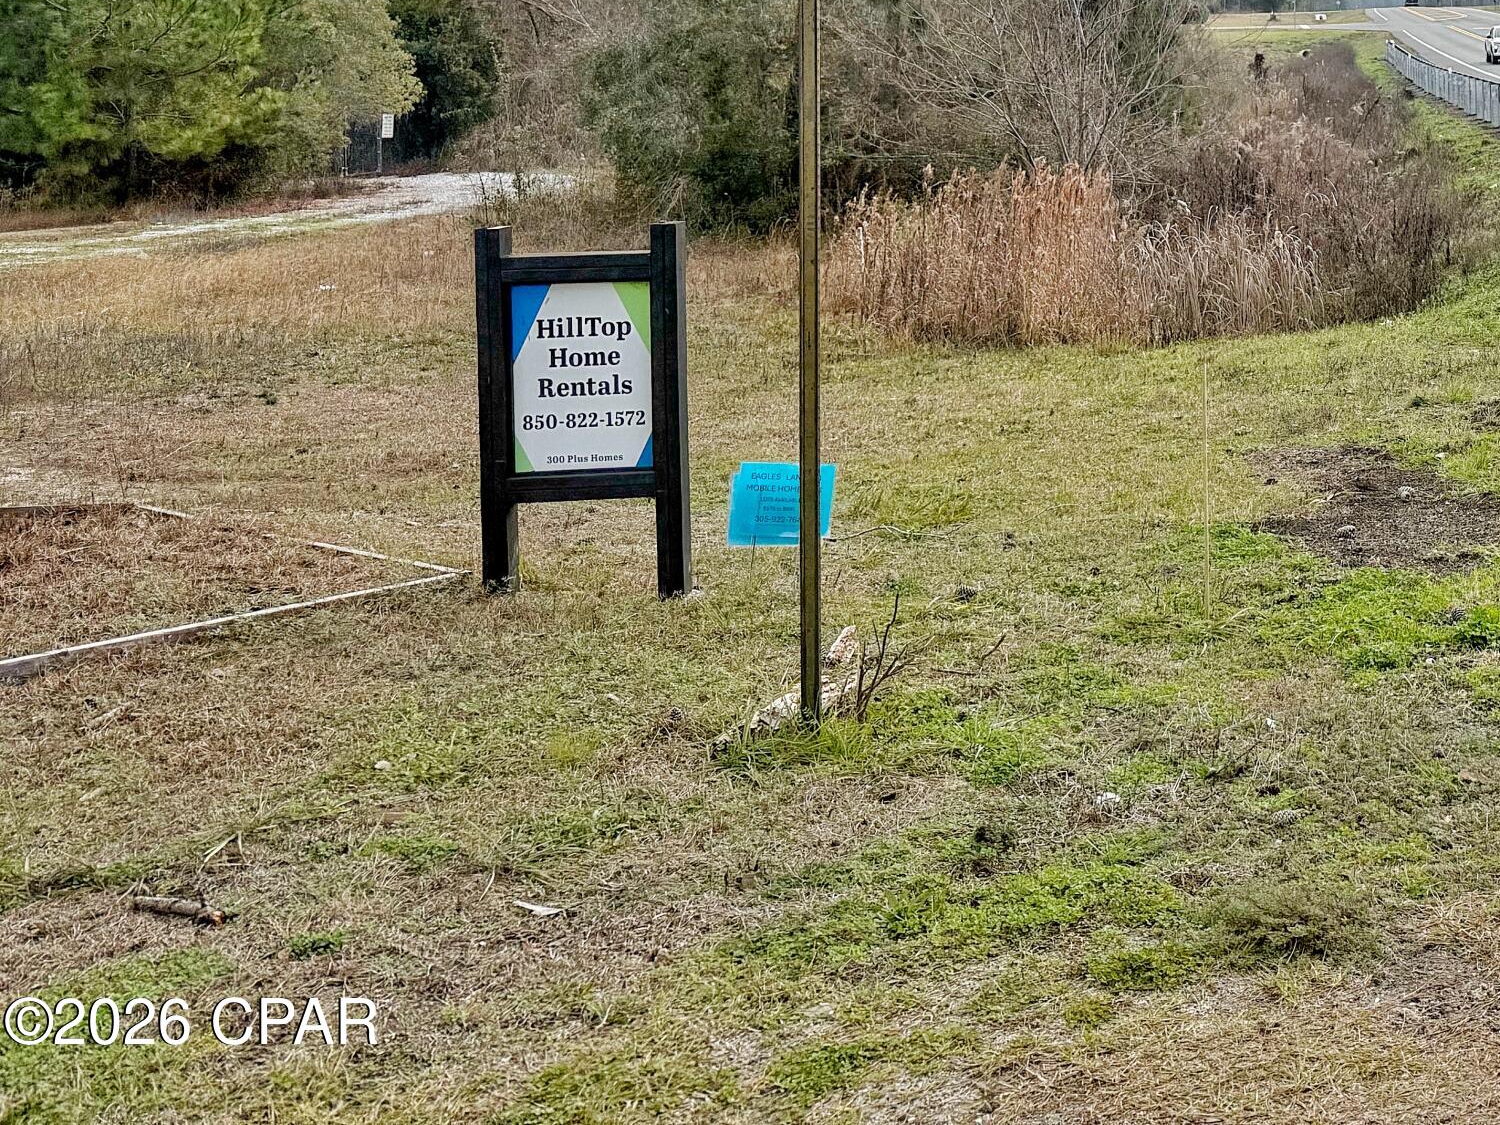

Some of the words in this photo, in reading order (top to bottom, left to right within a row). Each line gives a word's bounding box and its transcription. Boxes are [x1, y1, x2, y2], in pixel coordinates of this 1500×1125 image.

[536, 316, 632, 341] HillTop
[548, 348, 621, 367] Home
[537, 374, 633, 398] Rentals
[522, 410, 646, 431] 850-822-1572
[546, 455, 565, 464] 300
[567, 454, 589, 463] Plus
[590, 453, 624, 462] Homes
[751, 472, 782, 481] EAGLES
[746, 483, 776, 492] MOBILE
